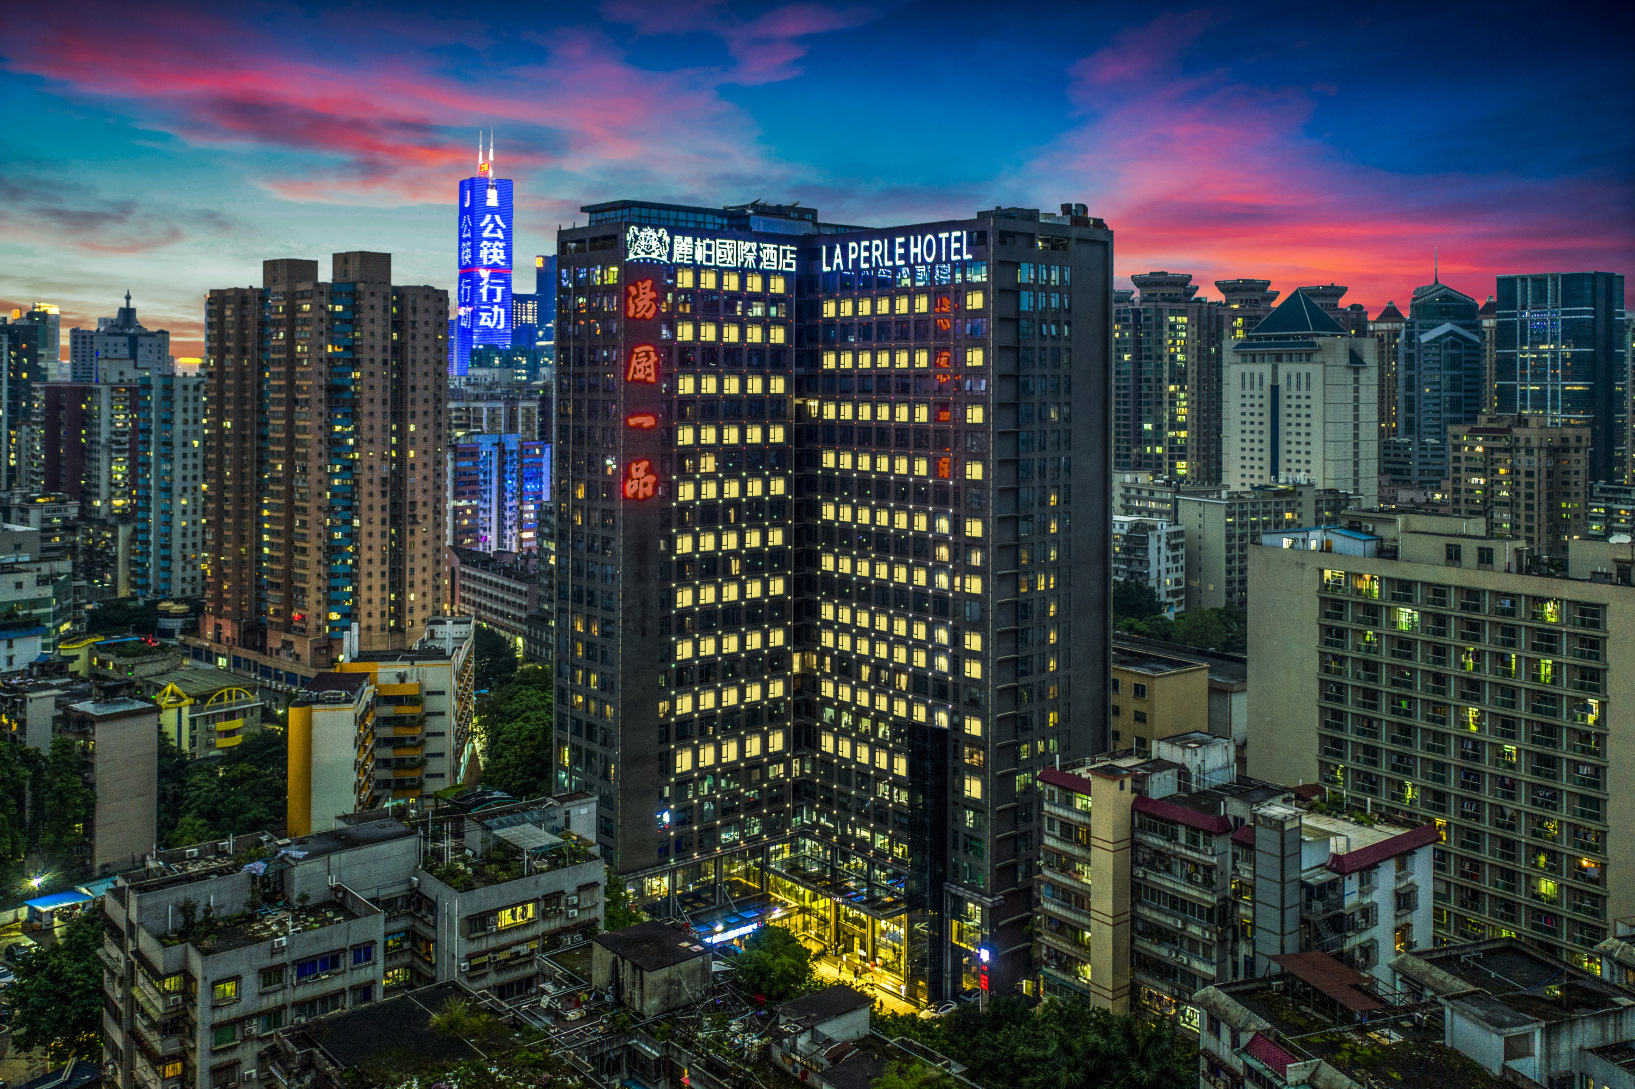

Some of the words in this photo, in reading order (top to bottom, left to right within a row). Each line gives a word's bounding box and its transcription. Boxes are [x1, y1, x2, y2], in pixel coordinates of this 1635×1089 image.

[479, 214, 507, 329] 公筷行动
[672, 235, 798, 272] 麗柏國際酒店
[822, 244, 844, 272] LA
[848, 237, 905, 270] PERLE
[909, 230, 973, 264] HOTEL
